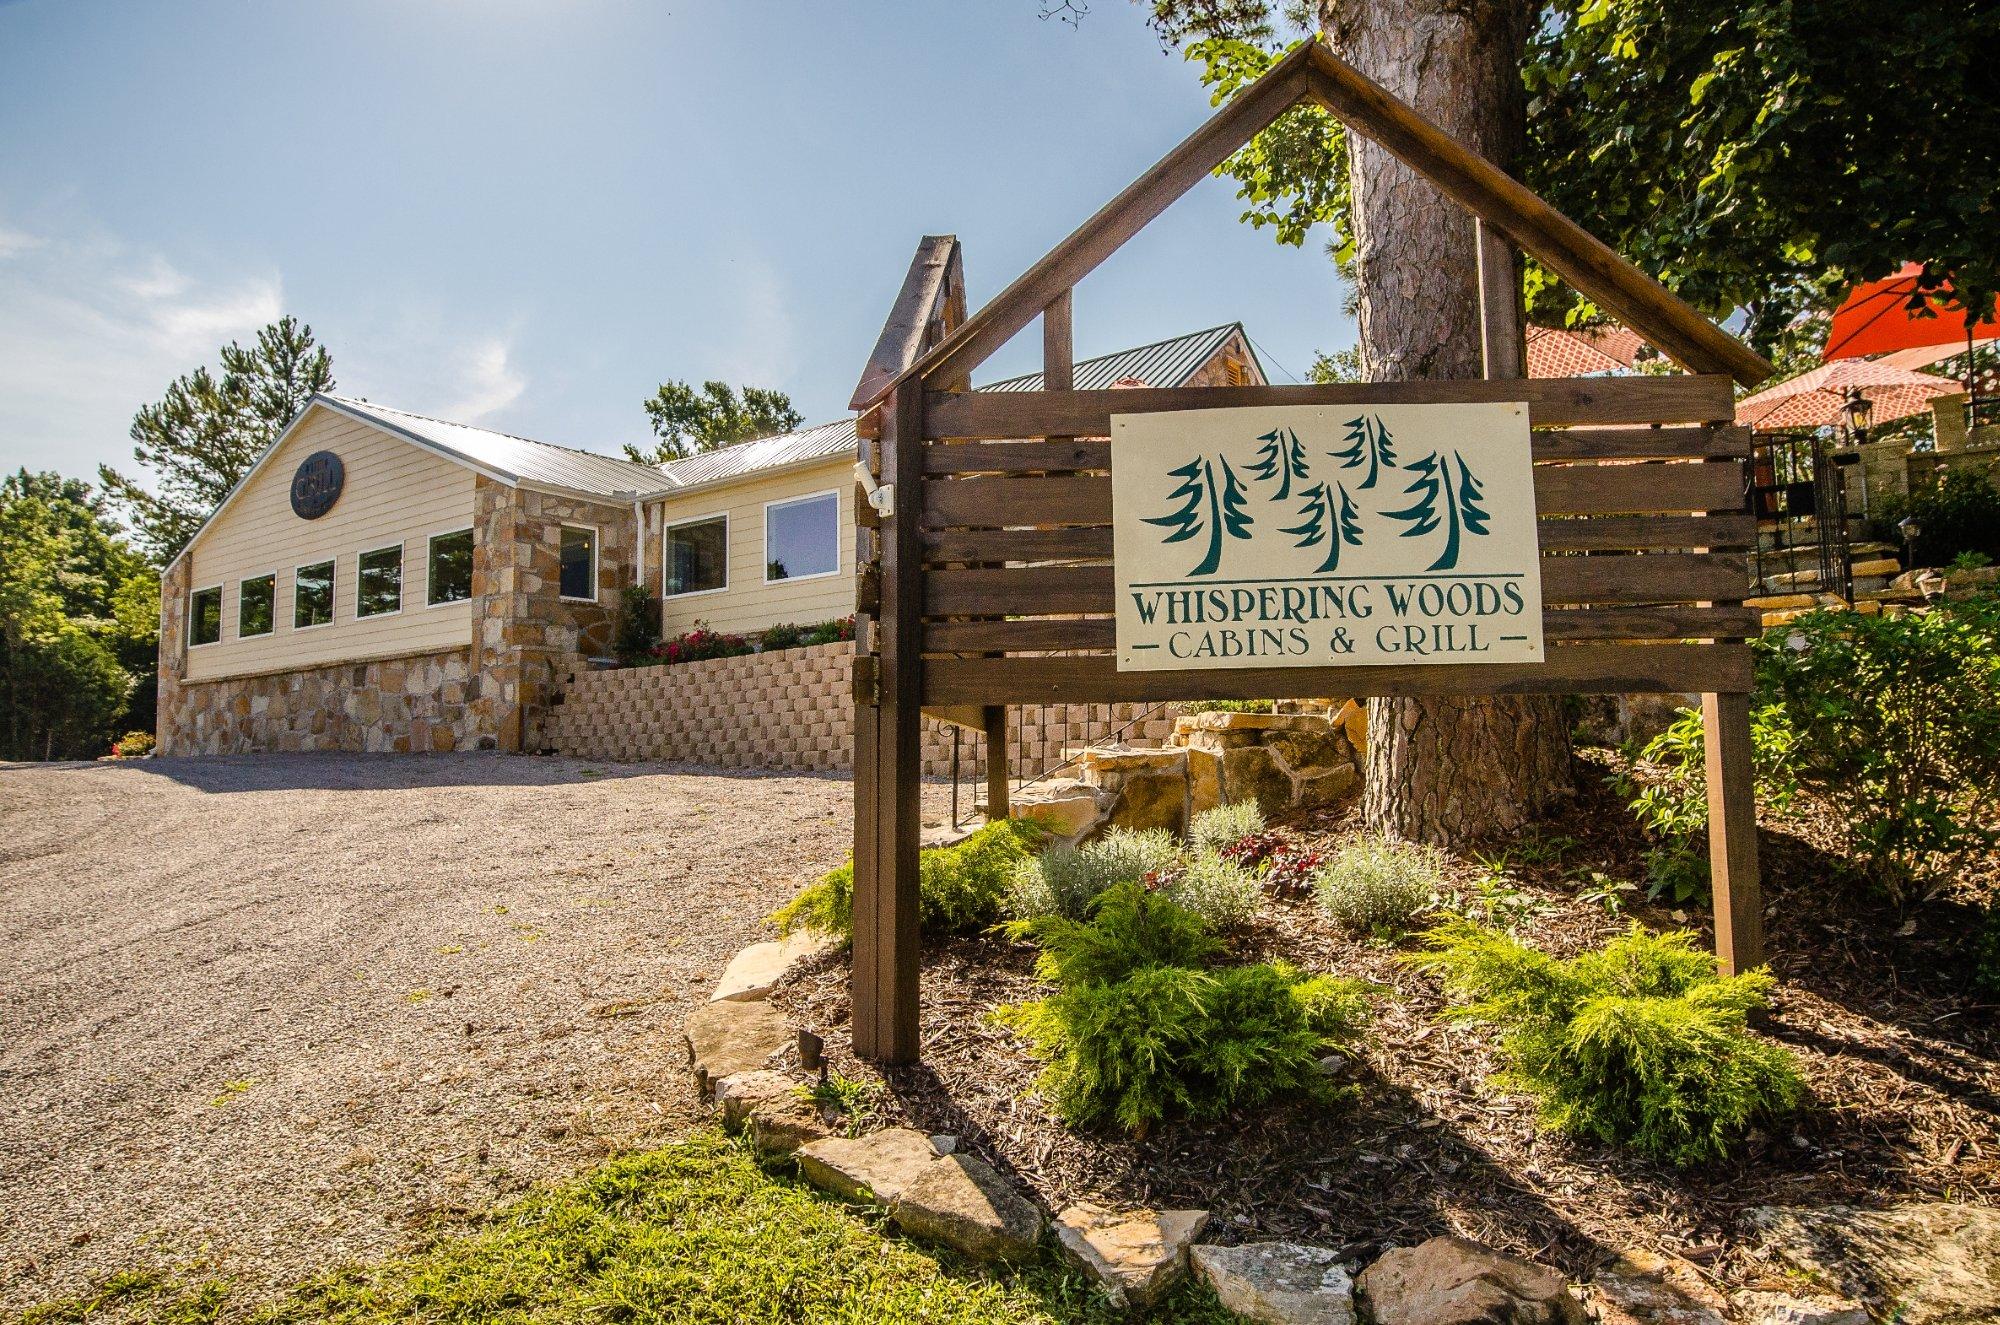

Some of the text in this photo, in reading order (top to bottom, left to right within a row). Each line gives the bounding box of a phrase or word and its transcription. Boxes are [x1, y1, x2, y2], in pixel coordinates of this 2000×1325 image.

[1131, 581, 1525, 625] WHISPERING WOODS
[1168, 624, 1490, 659] CABINS & GRILL
